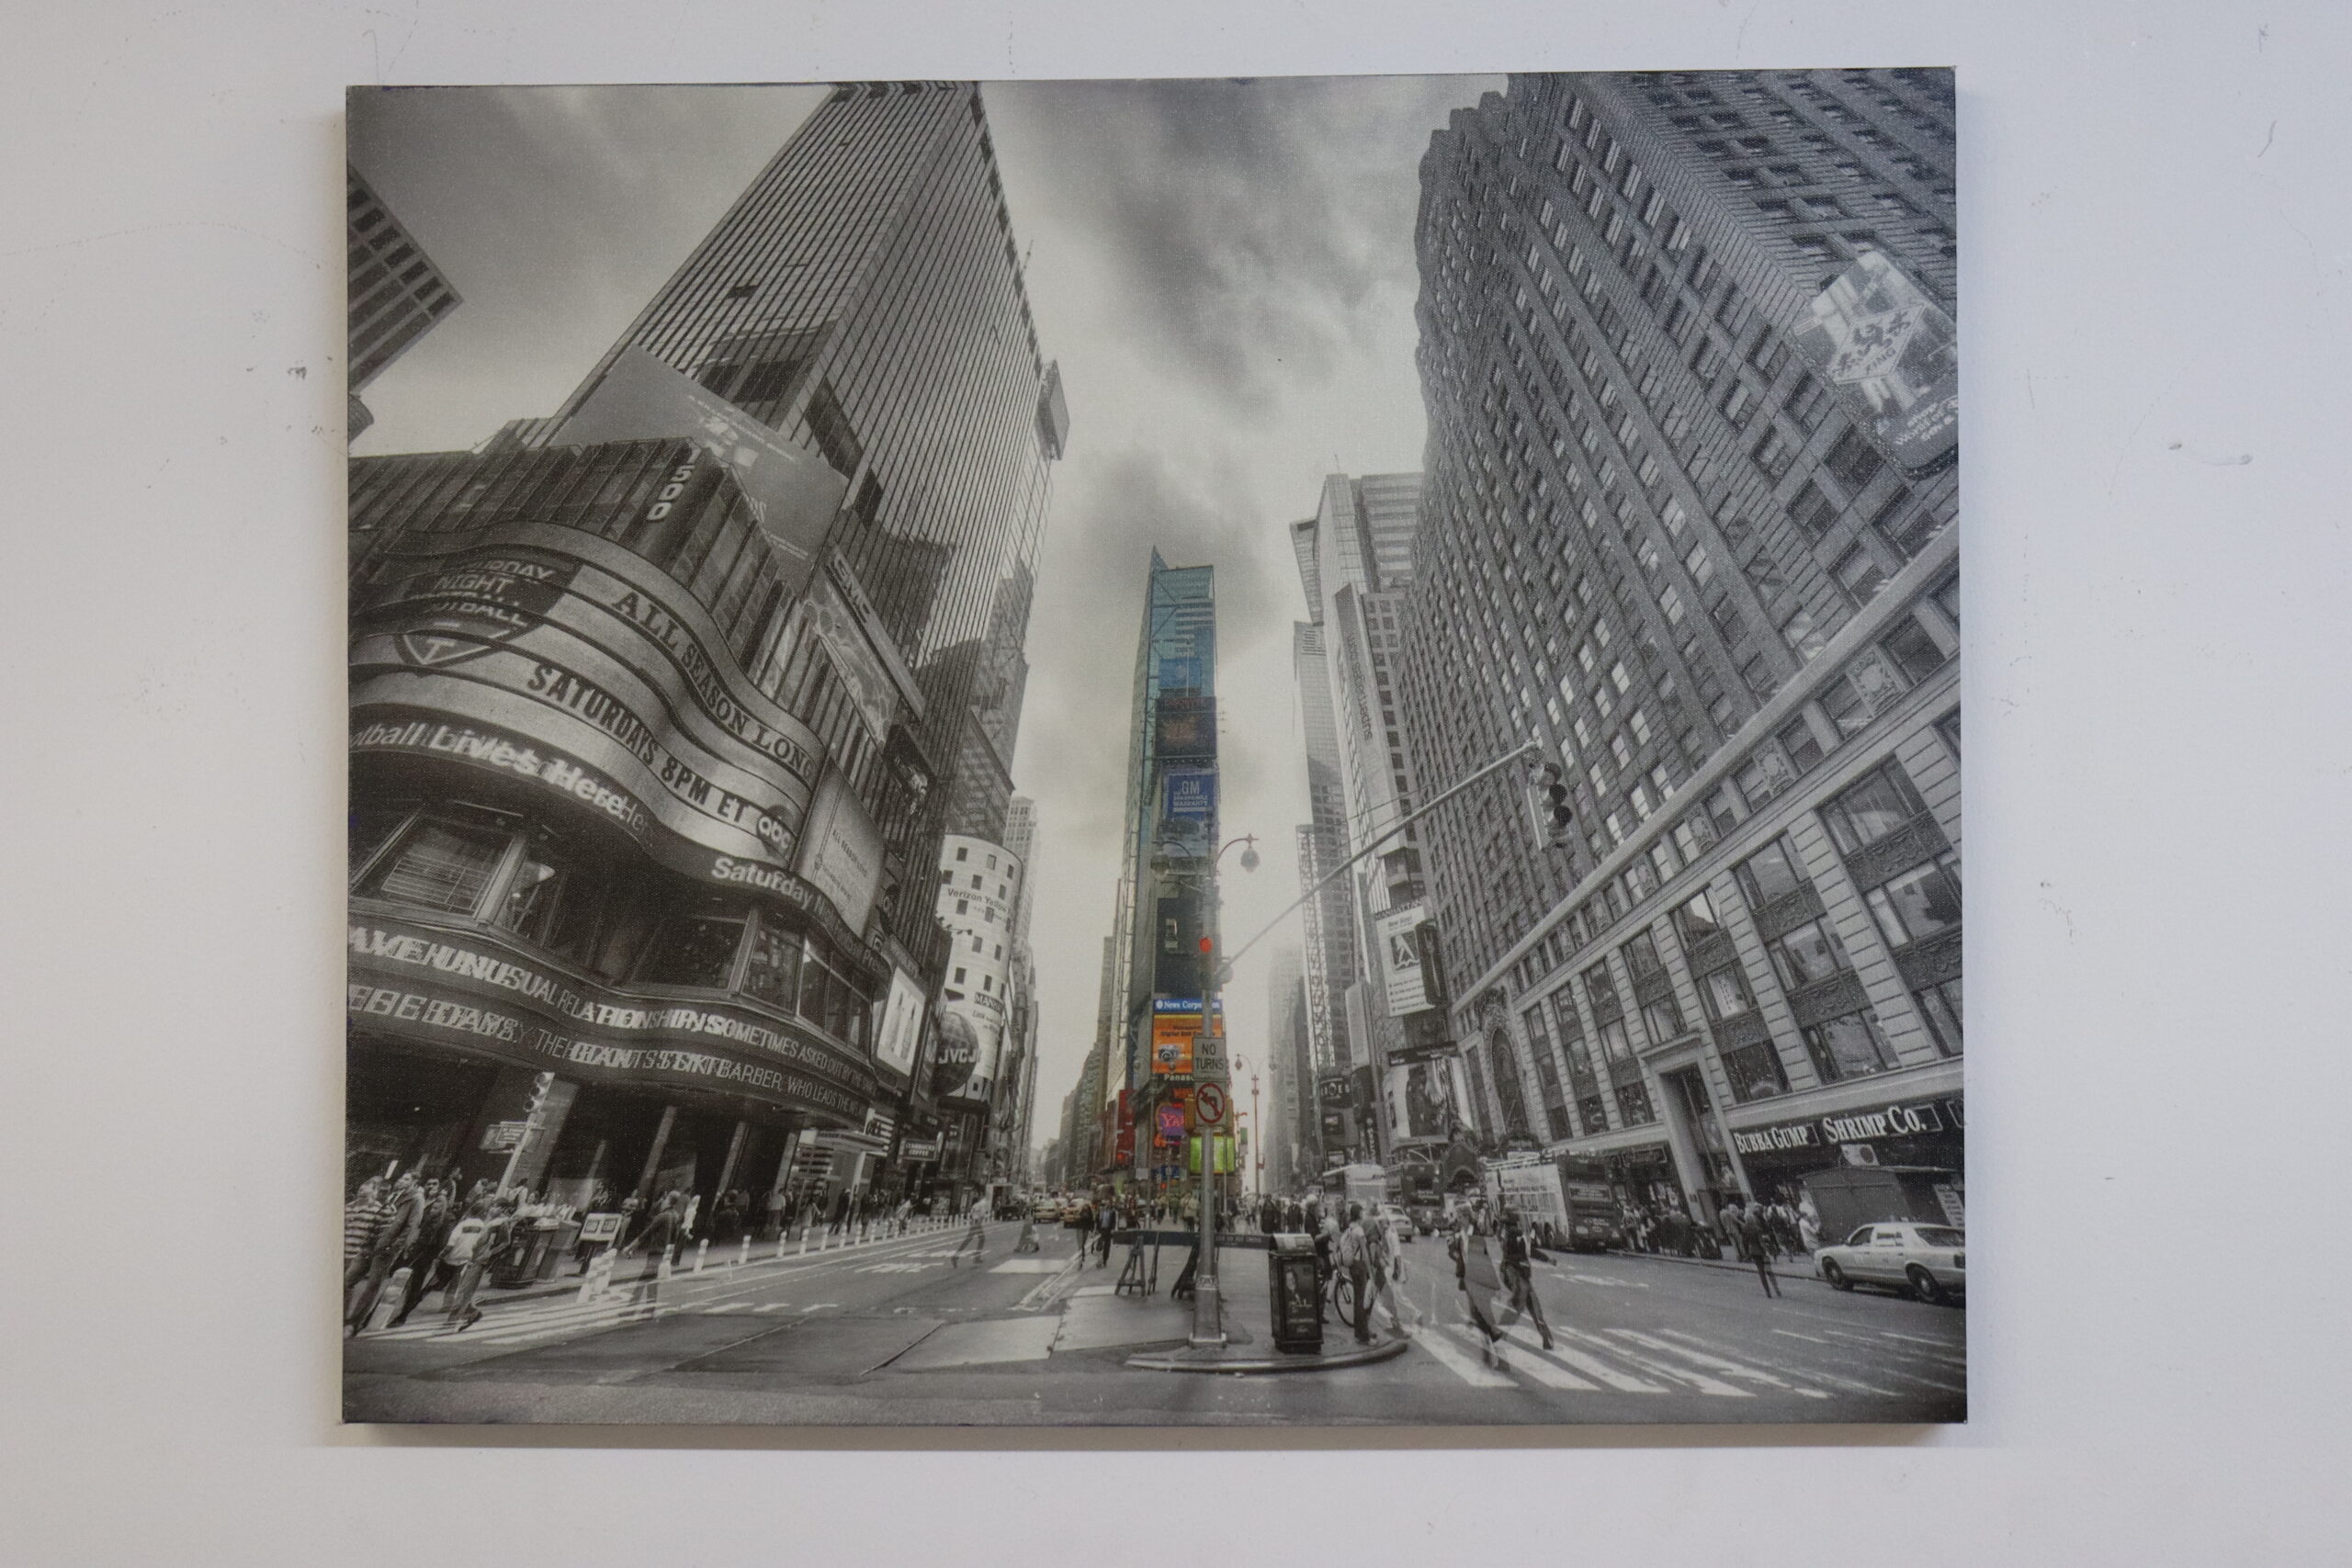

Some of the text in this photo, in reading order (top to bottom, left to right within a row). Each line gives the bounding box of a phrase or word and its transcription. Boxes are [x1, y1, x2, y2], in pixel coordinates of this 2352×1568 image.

[613, 592, 812, 779] ALL SEASON LONG
[526, 662, 659, 766] SATURDAYS
[661, 756, 713, 806] 8PM
[717, 787, 752, 824] ET
[1182, 780, 1201, 795] GM
[711, 856, 813, 910] Saturday
[1163, 999, 1181, 1009] News
[1195, 1056, 1224, 1070] TURNS
[1202, 1043, 1217, 1055] NO
[1733, 1131, 1772, 1155] BUBBA
[1770, 1126, 1809, 1149] GUMP
[1822, 1112, 1887, 1145] SHRIMP
